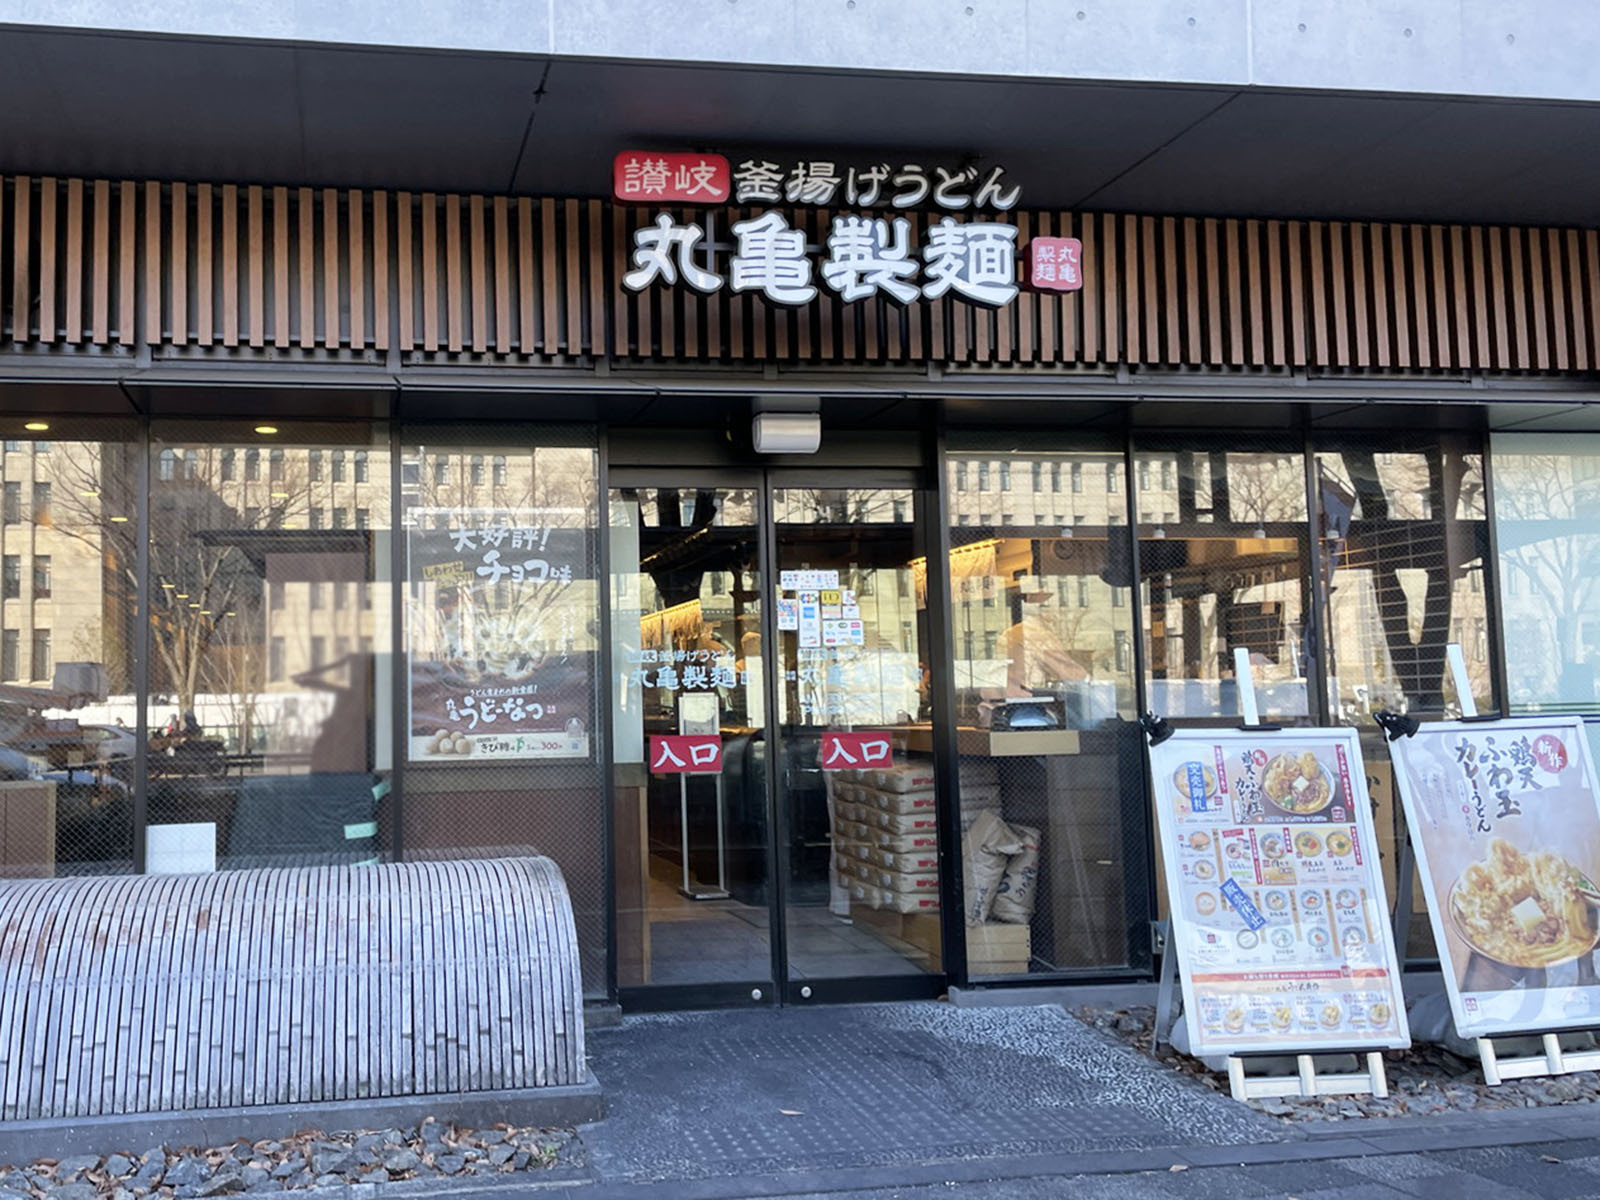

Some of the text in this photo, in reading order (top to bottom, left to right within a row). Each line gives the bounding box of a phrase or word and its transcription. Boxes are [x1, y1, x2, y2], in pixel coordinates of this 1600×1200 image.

[623, 158, 1021, 209] 讃岐 釜揚げうどん
[622, 211, 1019, 306] 丸亀製麺
[654, 740, 720, 769] 入口
[826, 737, 891, 764] 入口
[1455, 737, 1492, 832] カレーうどん
